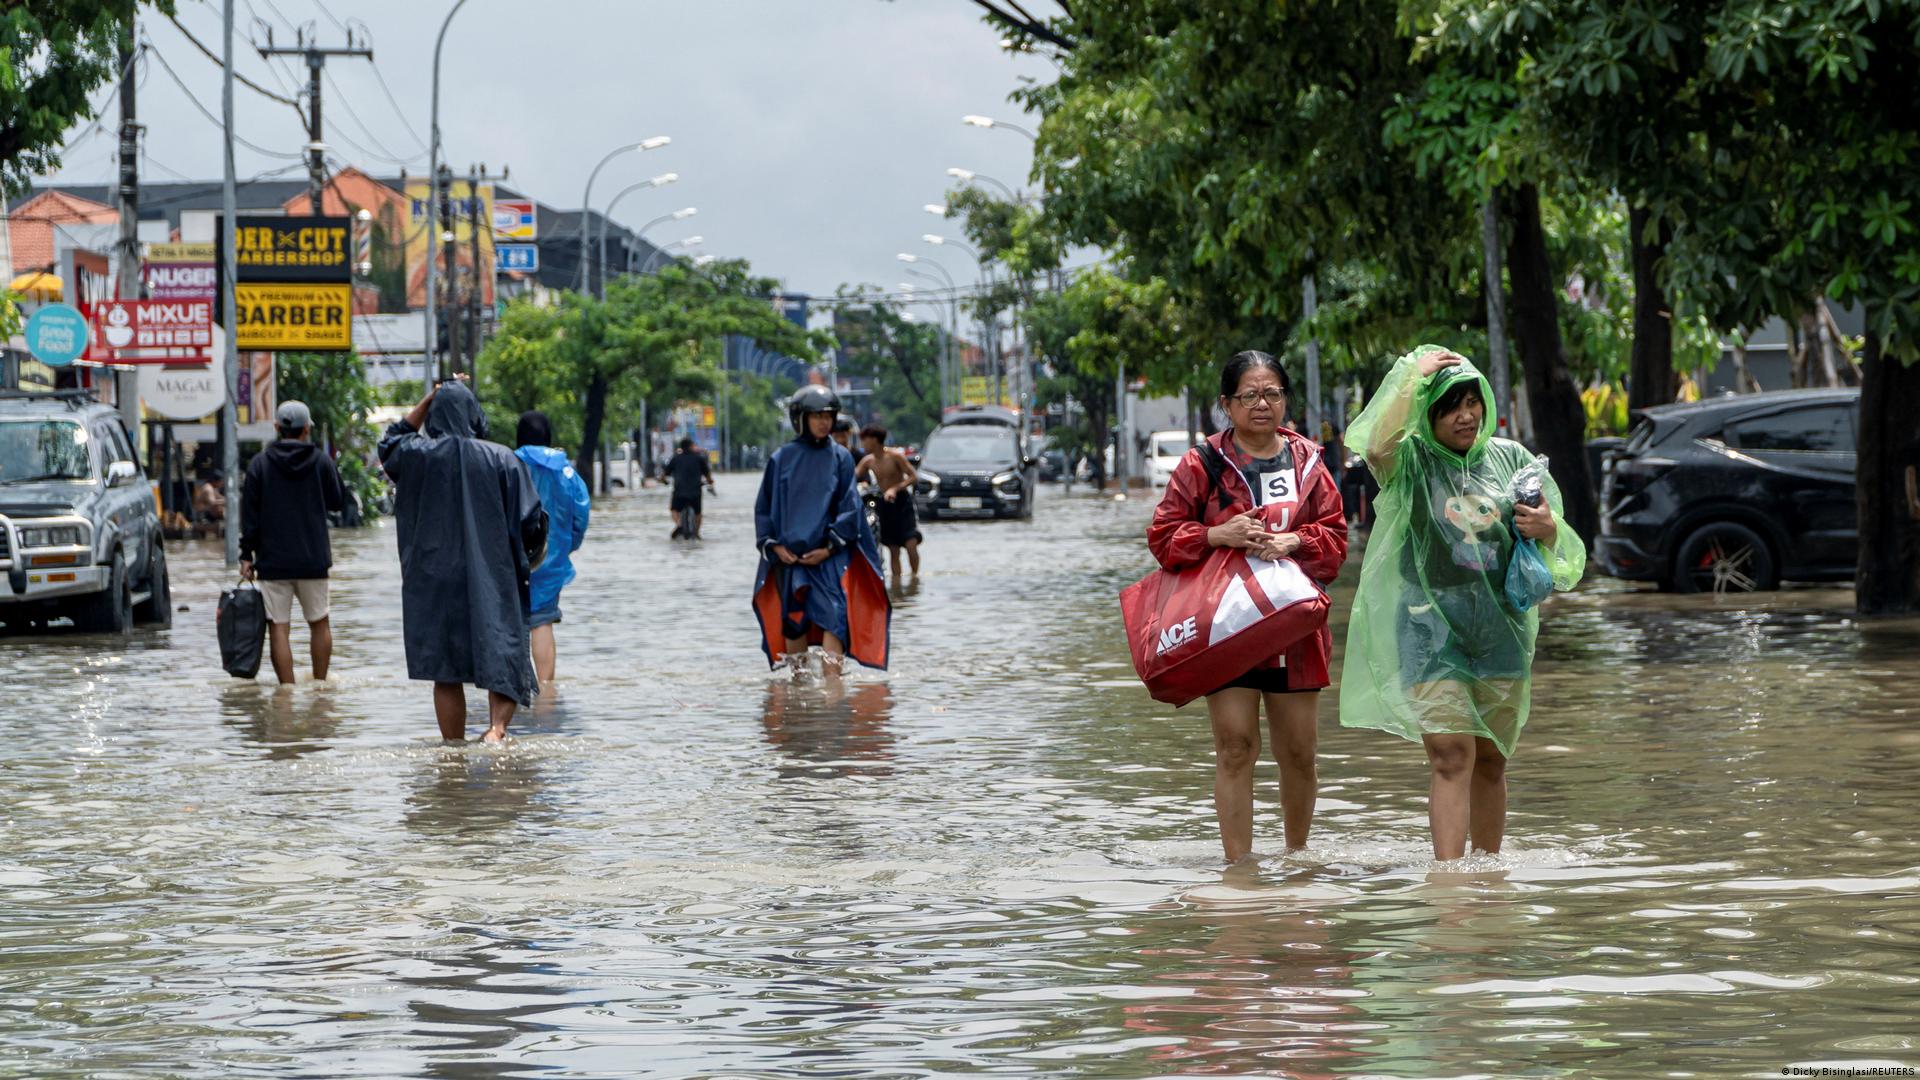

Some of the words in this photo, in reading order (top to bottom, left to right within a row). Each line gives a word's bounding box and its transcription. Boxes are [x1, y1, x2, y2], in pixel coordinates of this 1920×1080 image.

[298, 227, 346, 251] CUT
[236, 251, 346, 266] ARBERSHOP
[136, 303, 209, 324] MIXUE
[236, 305, 344, 326] BARBER
[39, 325, 75, 338] Grab
[38, 337, 73, 353] Food
[1268, 476, 1289, 497] S
[1270, 507, 1289, 531] J
[1156, 615, 1197, 653] ACE
